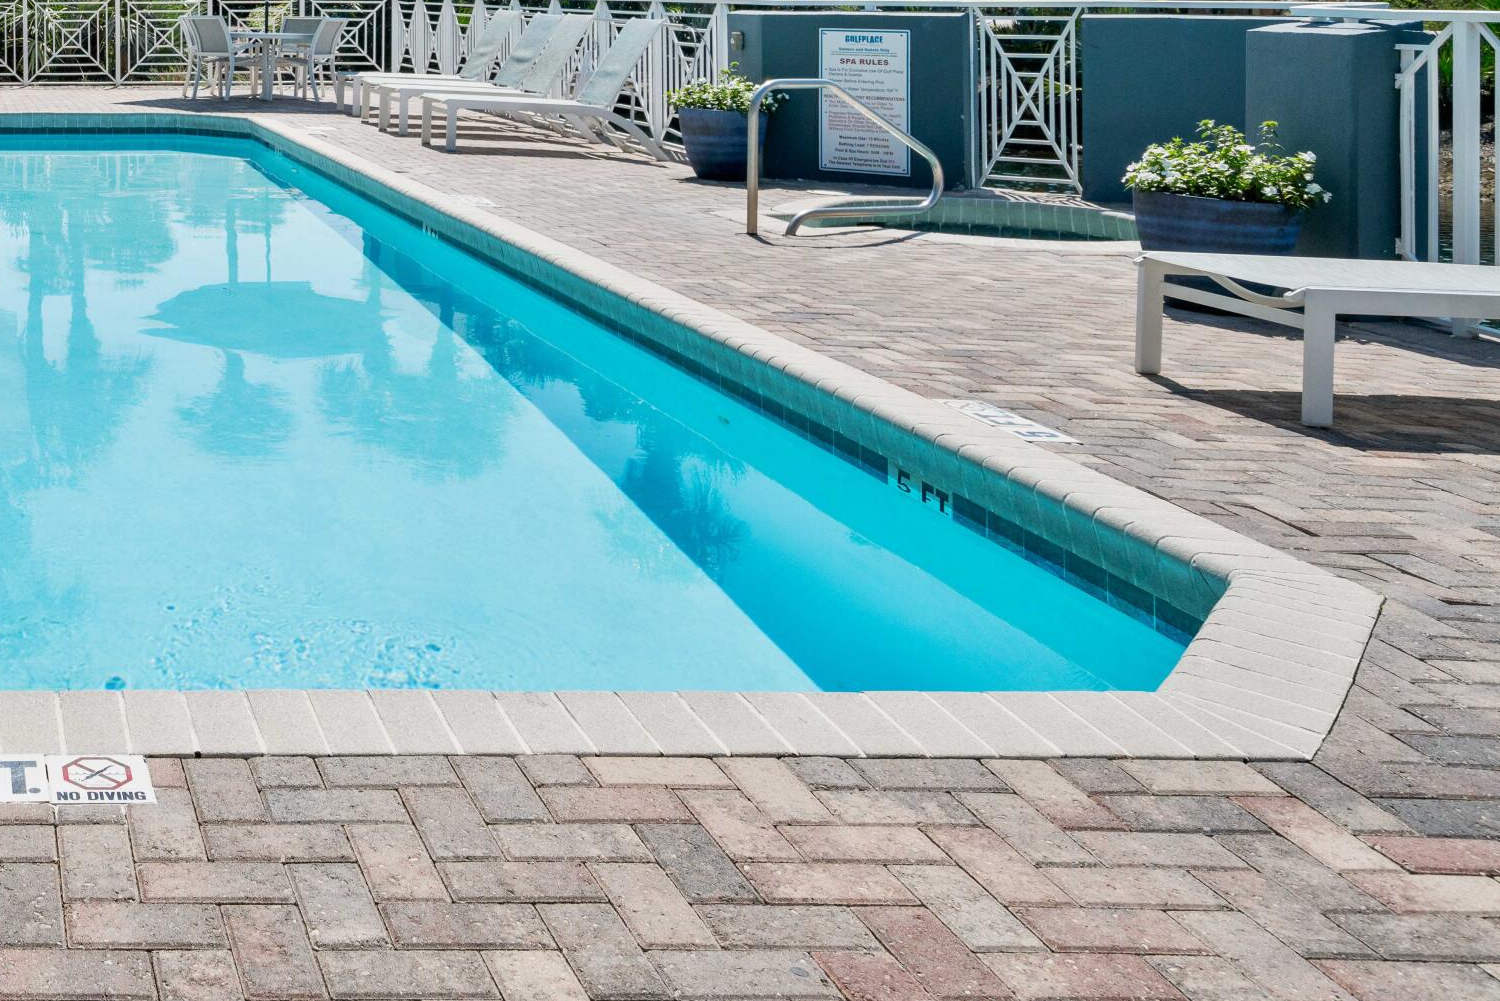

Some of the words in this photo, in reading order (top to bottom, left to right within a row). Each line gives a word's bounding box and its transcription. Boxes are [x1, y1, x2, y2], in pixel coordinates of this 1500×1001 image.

[845, 35, 884, 44] GULFPLACE
[896, 468, 911, 493] 5
[56, 791, 80, 801] NO
[87, 791, 146, 801] DIVING
